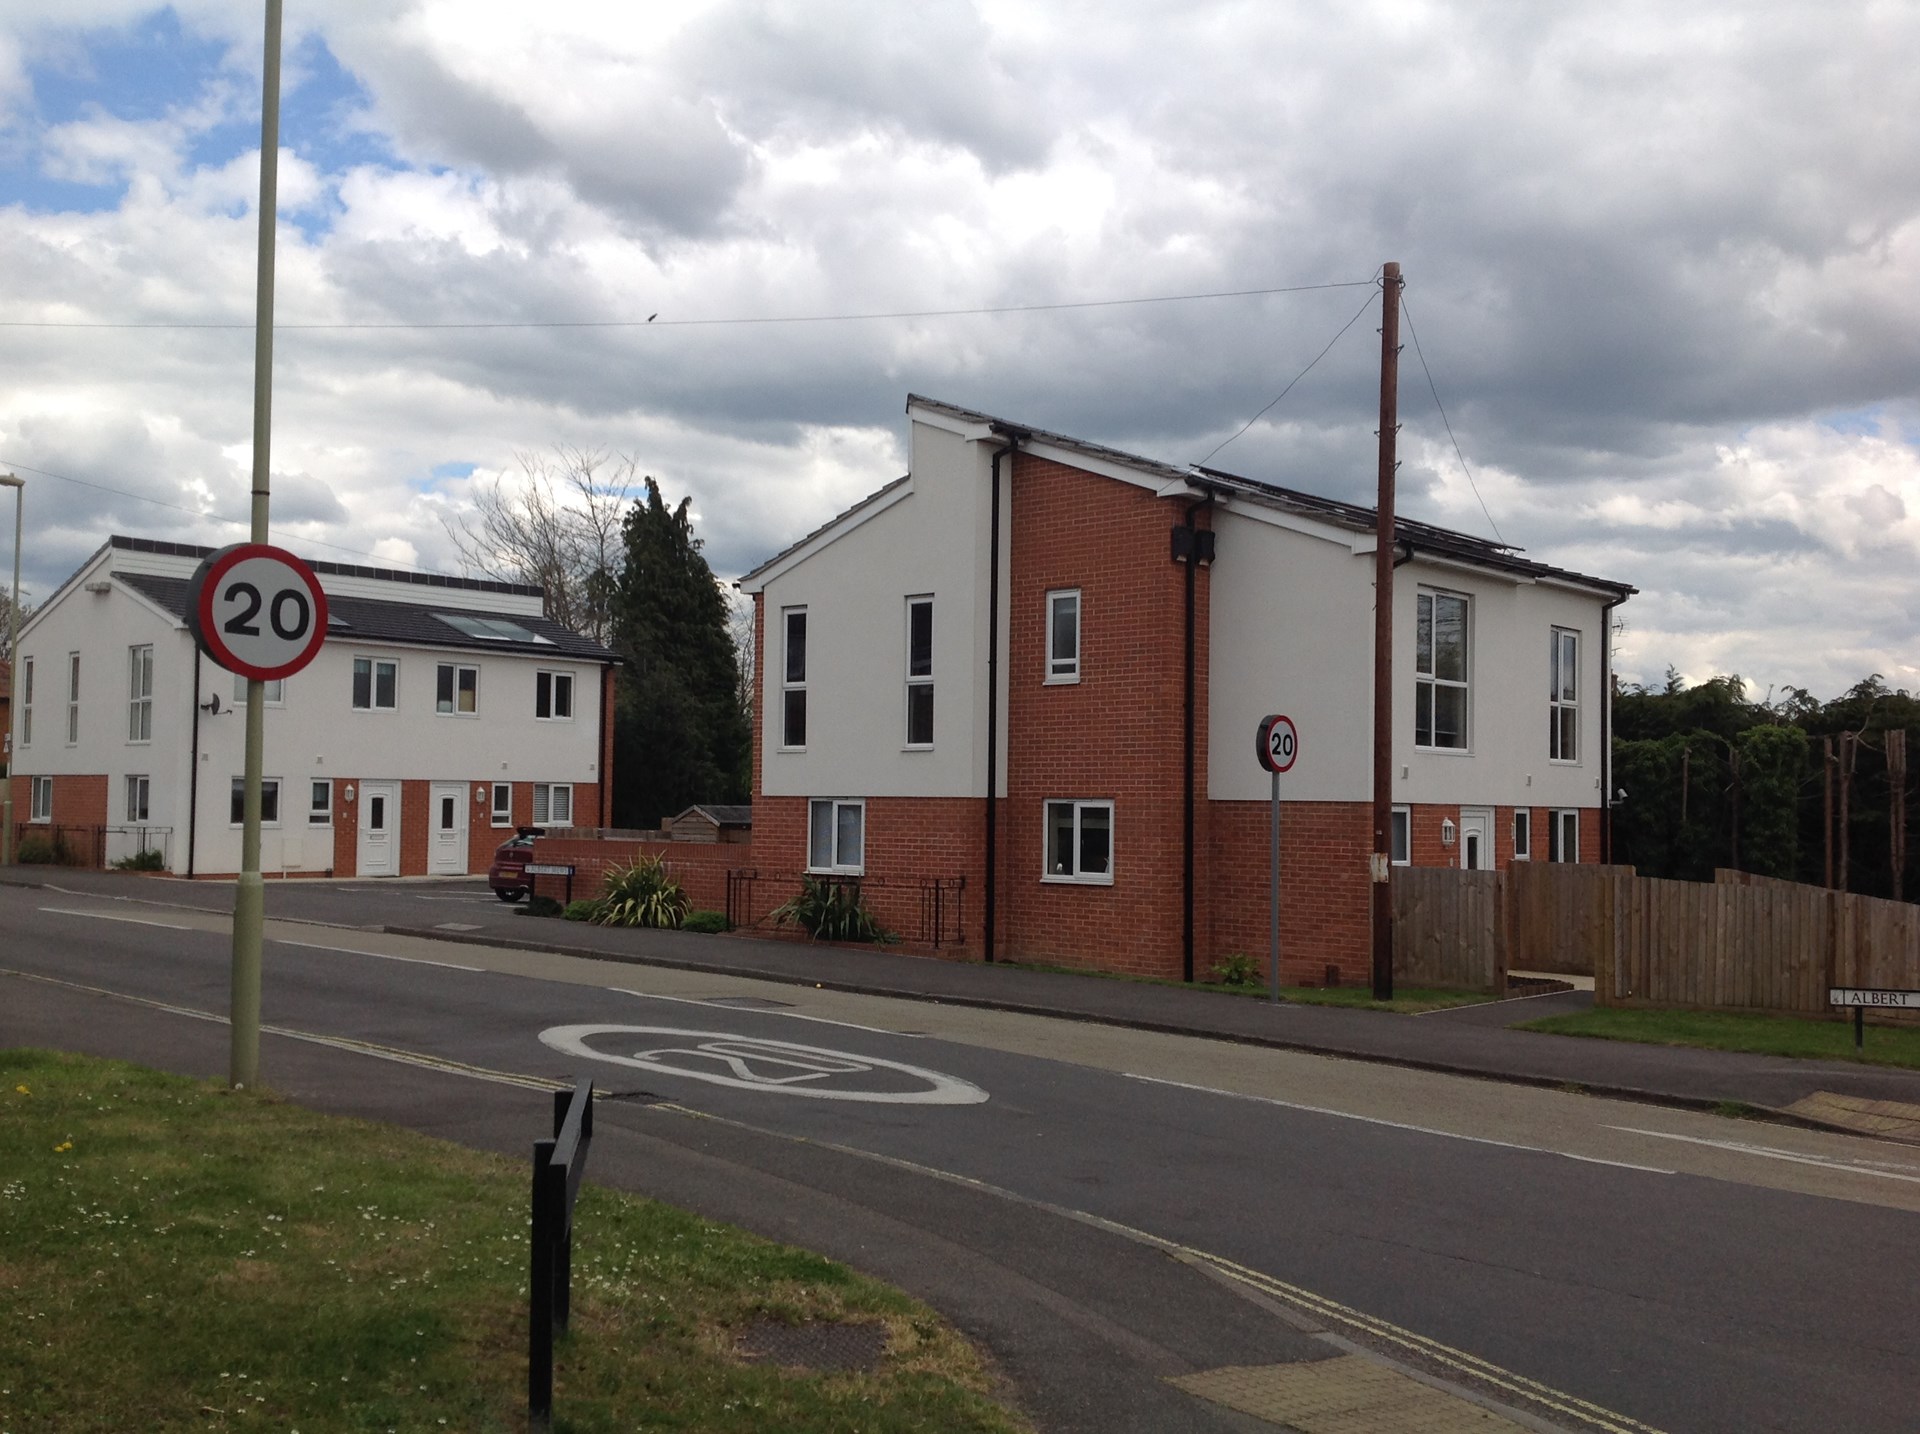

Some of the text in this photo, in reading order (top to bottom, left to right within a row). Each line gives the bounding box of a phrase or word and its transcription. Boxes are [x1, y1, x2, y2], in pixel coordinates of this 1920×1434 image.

[224, 582, 309, 641] 20
[1271, 732, 1293, 756] 20
[1851, 992, 1909, 1005] ALBERT
[633, 1042, 873, 1084] 20
